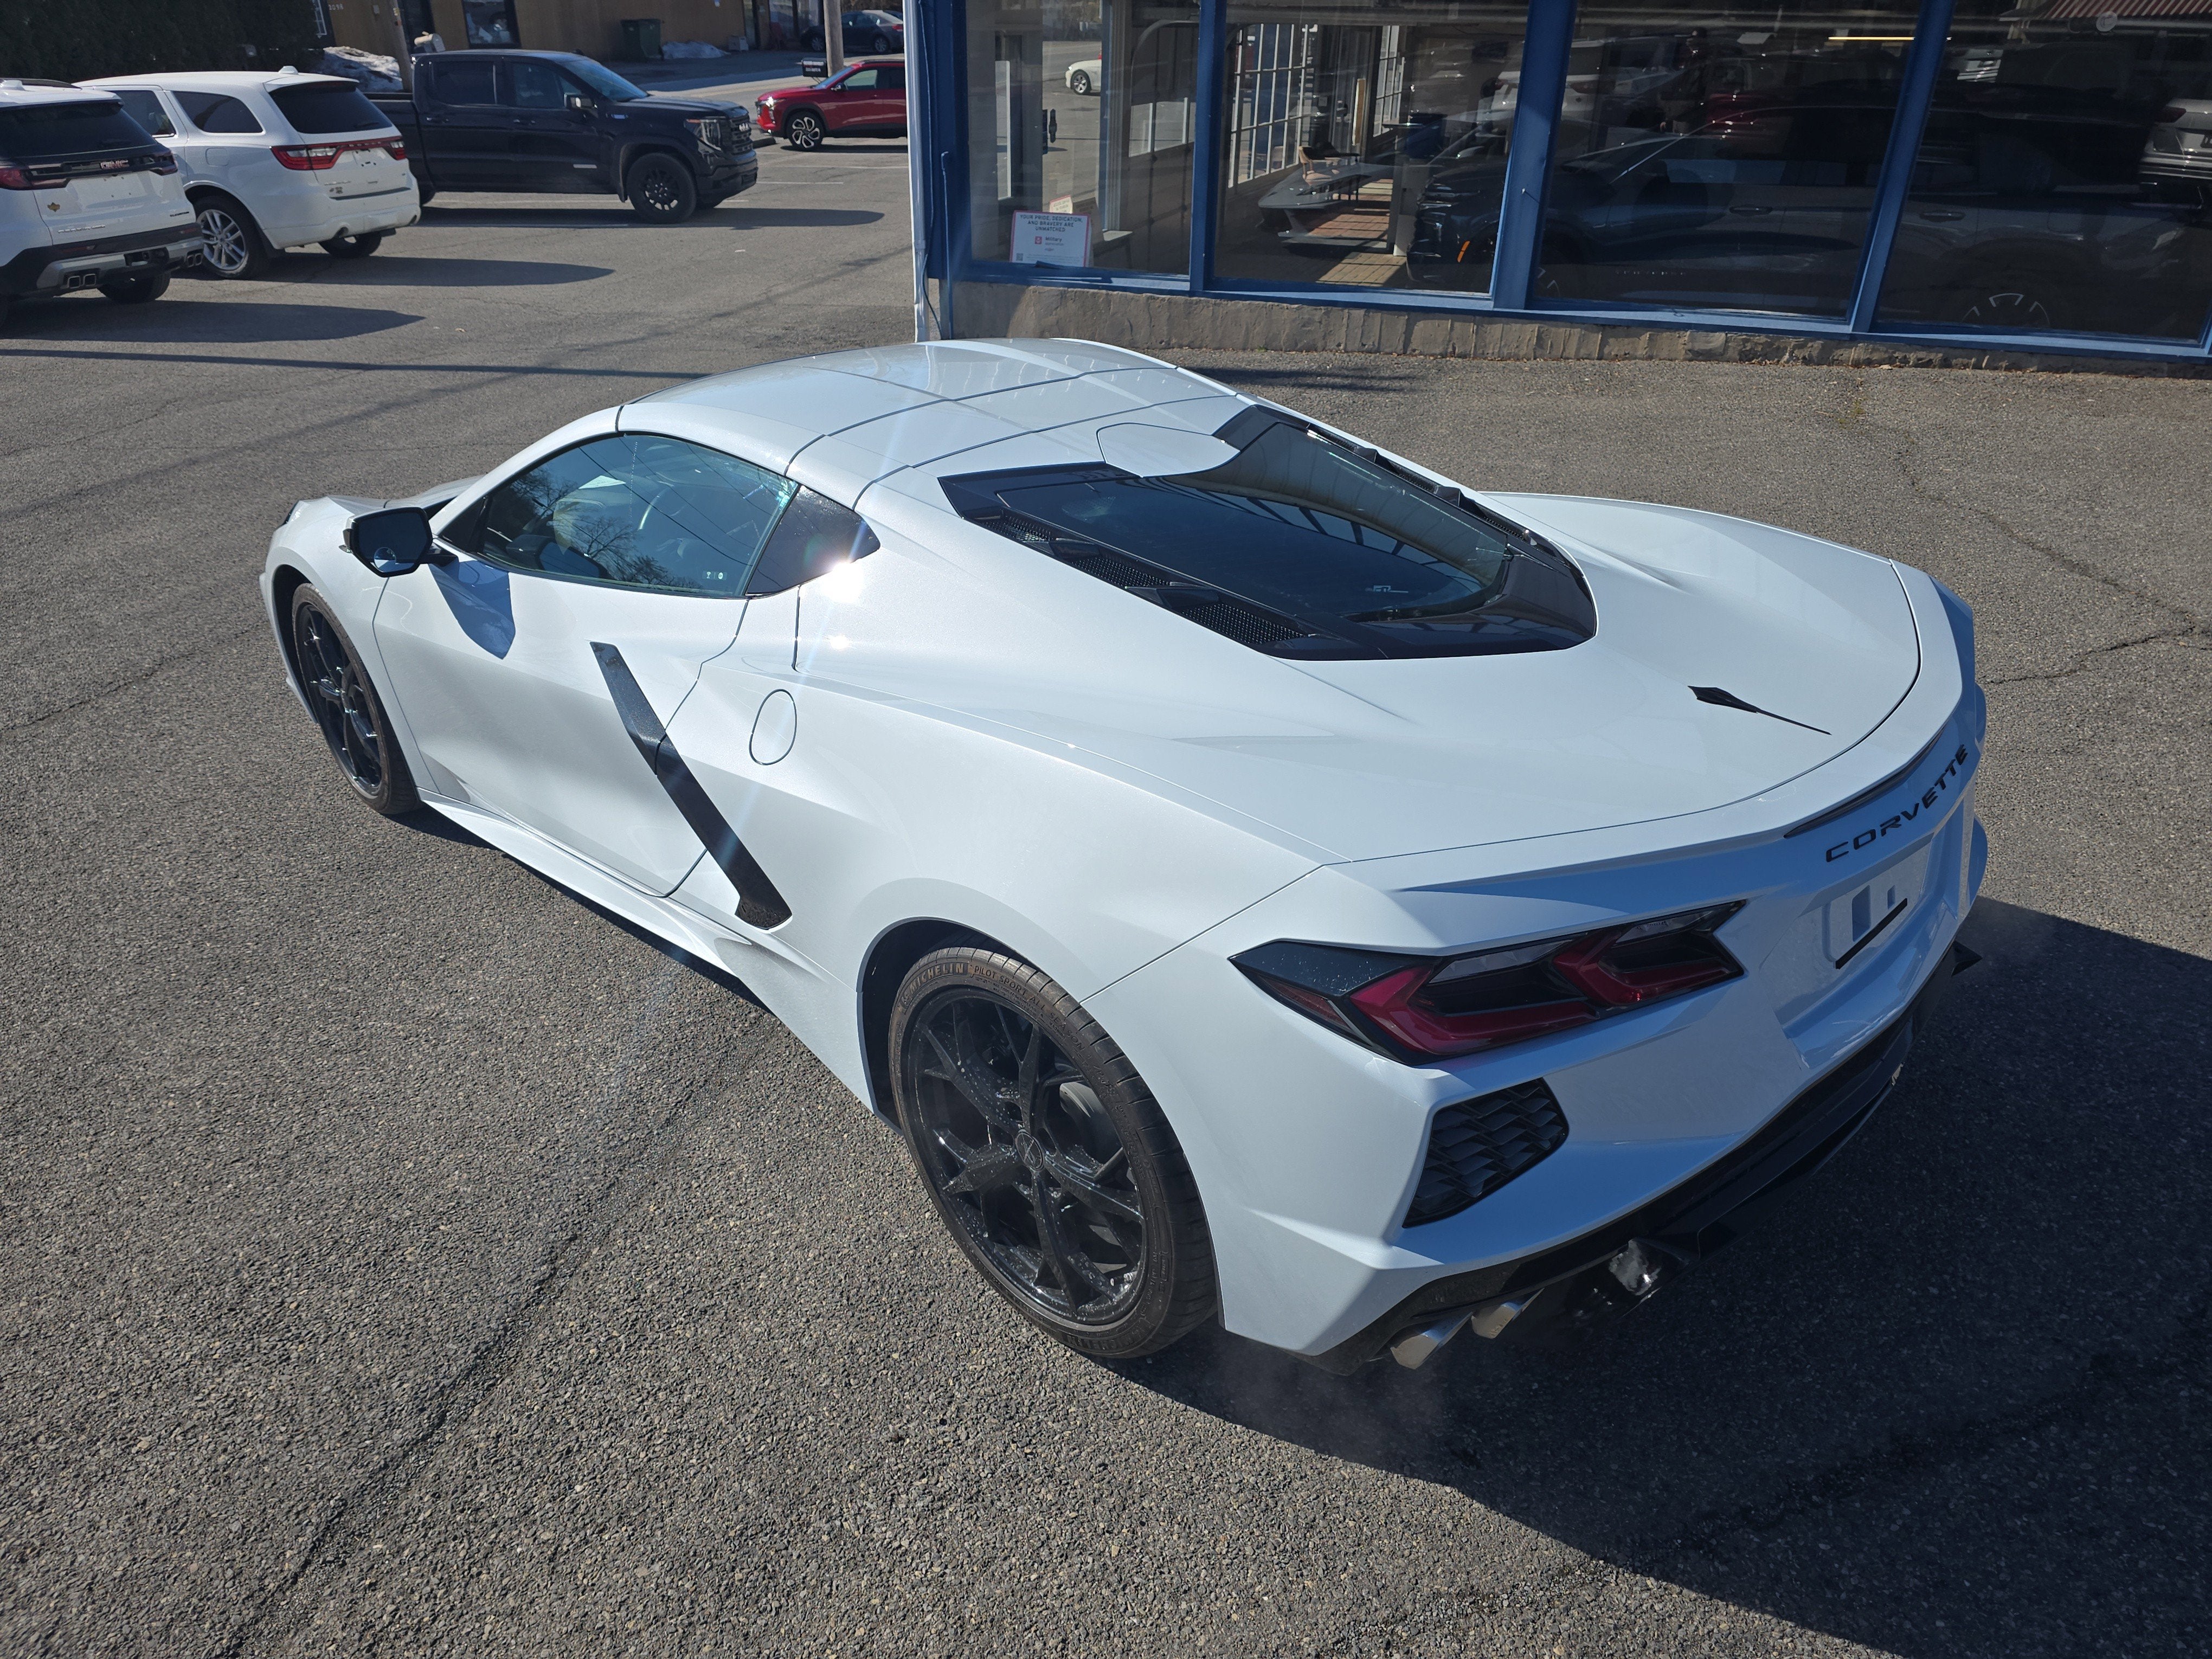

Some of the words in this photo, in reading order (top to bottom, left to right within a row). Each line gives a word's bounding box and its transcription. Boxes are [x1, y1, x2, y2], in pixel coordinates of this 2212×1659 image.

[1826, 744, 1968, 863] CORVETTE
[910, 963, 964, 994] MICHELIN
[974, 966, 996, 979] PILOT
[1000, 975, 1030, 996] SPORT
[1030, 995, 1045, 1011] ALL
[1050, 1012, 1086, 1051] SEASON
